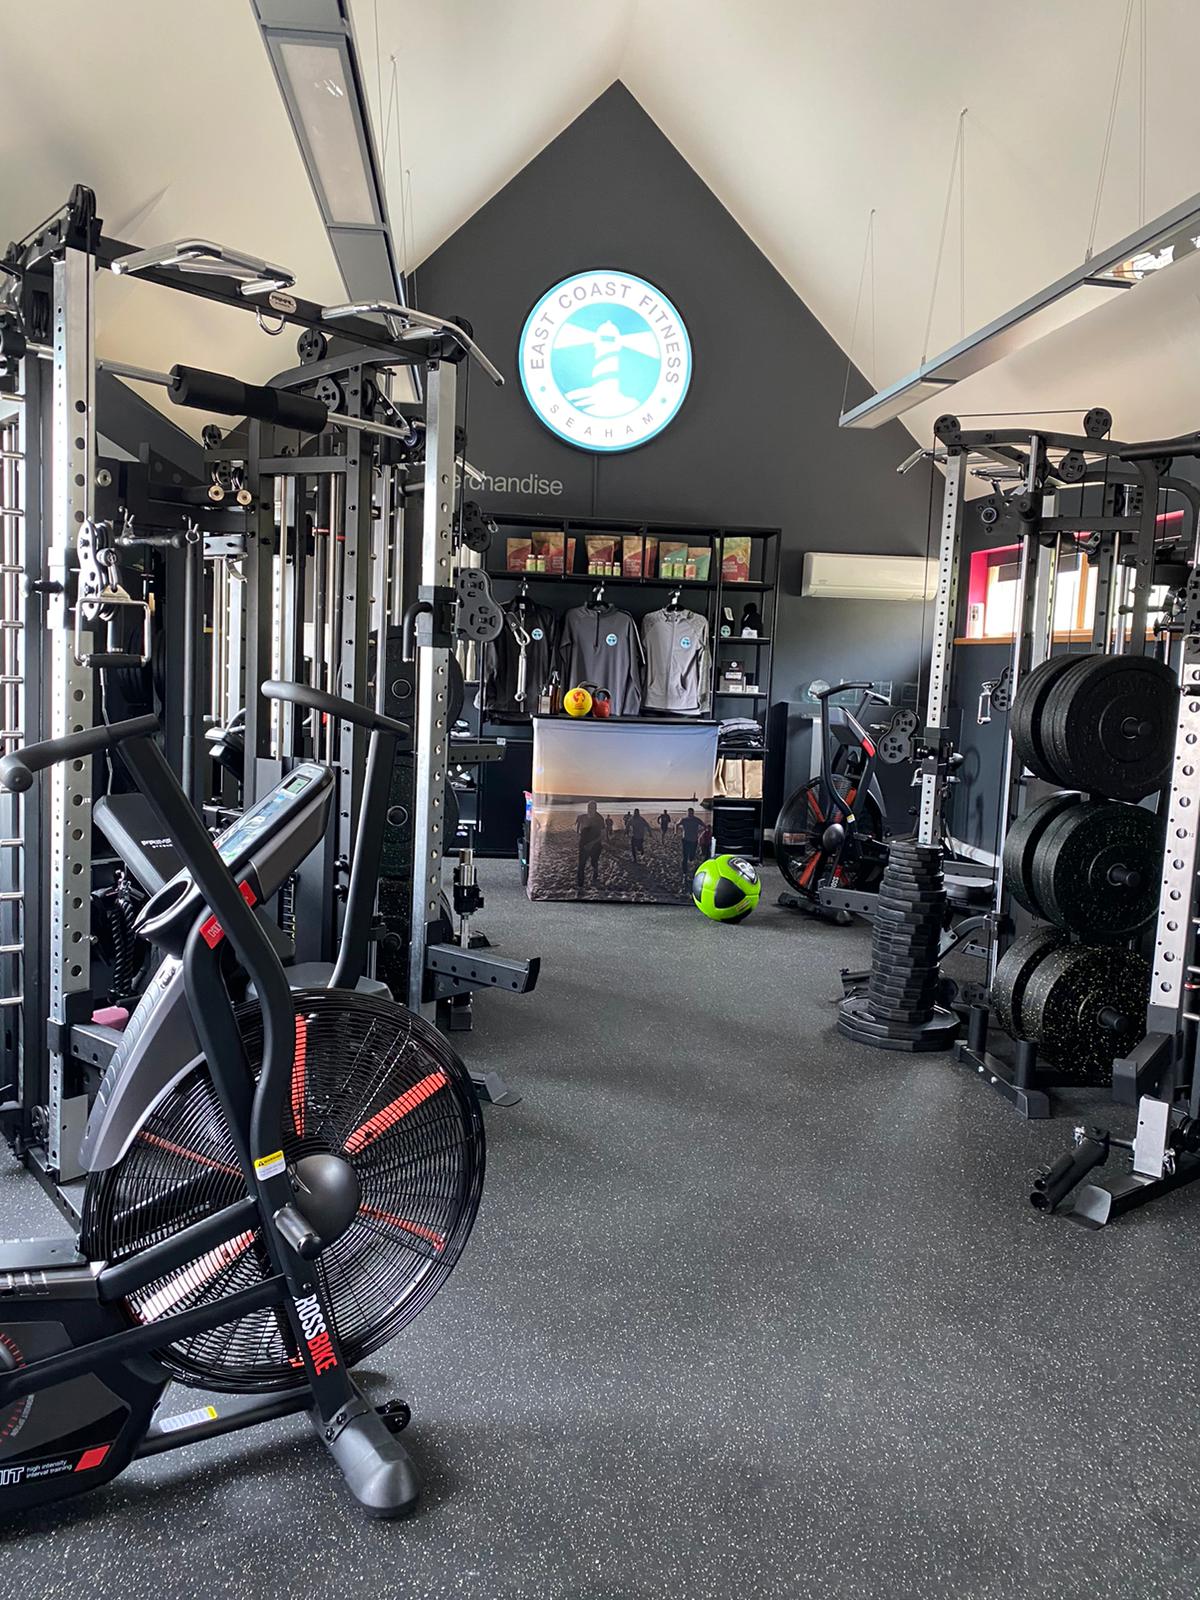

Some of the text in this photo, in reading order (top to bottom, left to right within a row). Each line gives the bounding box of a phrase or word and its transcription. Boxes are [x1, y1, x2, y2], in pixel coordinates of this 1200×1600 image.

[530, 281, 681, 384] EAST COAST FITNESS
[550, 404, 654, 438] SEAHAM
[454, 470, 563, 496] erchandise
[292, 1293, 338, 1376] ROSSBIKE
